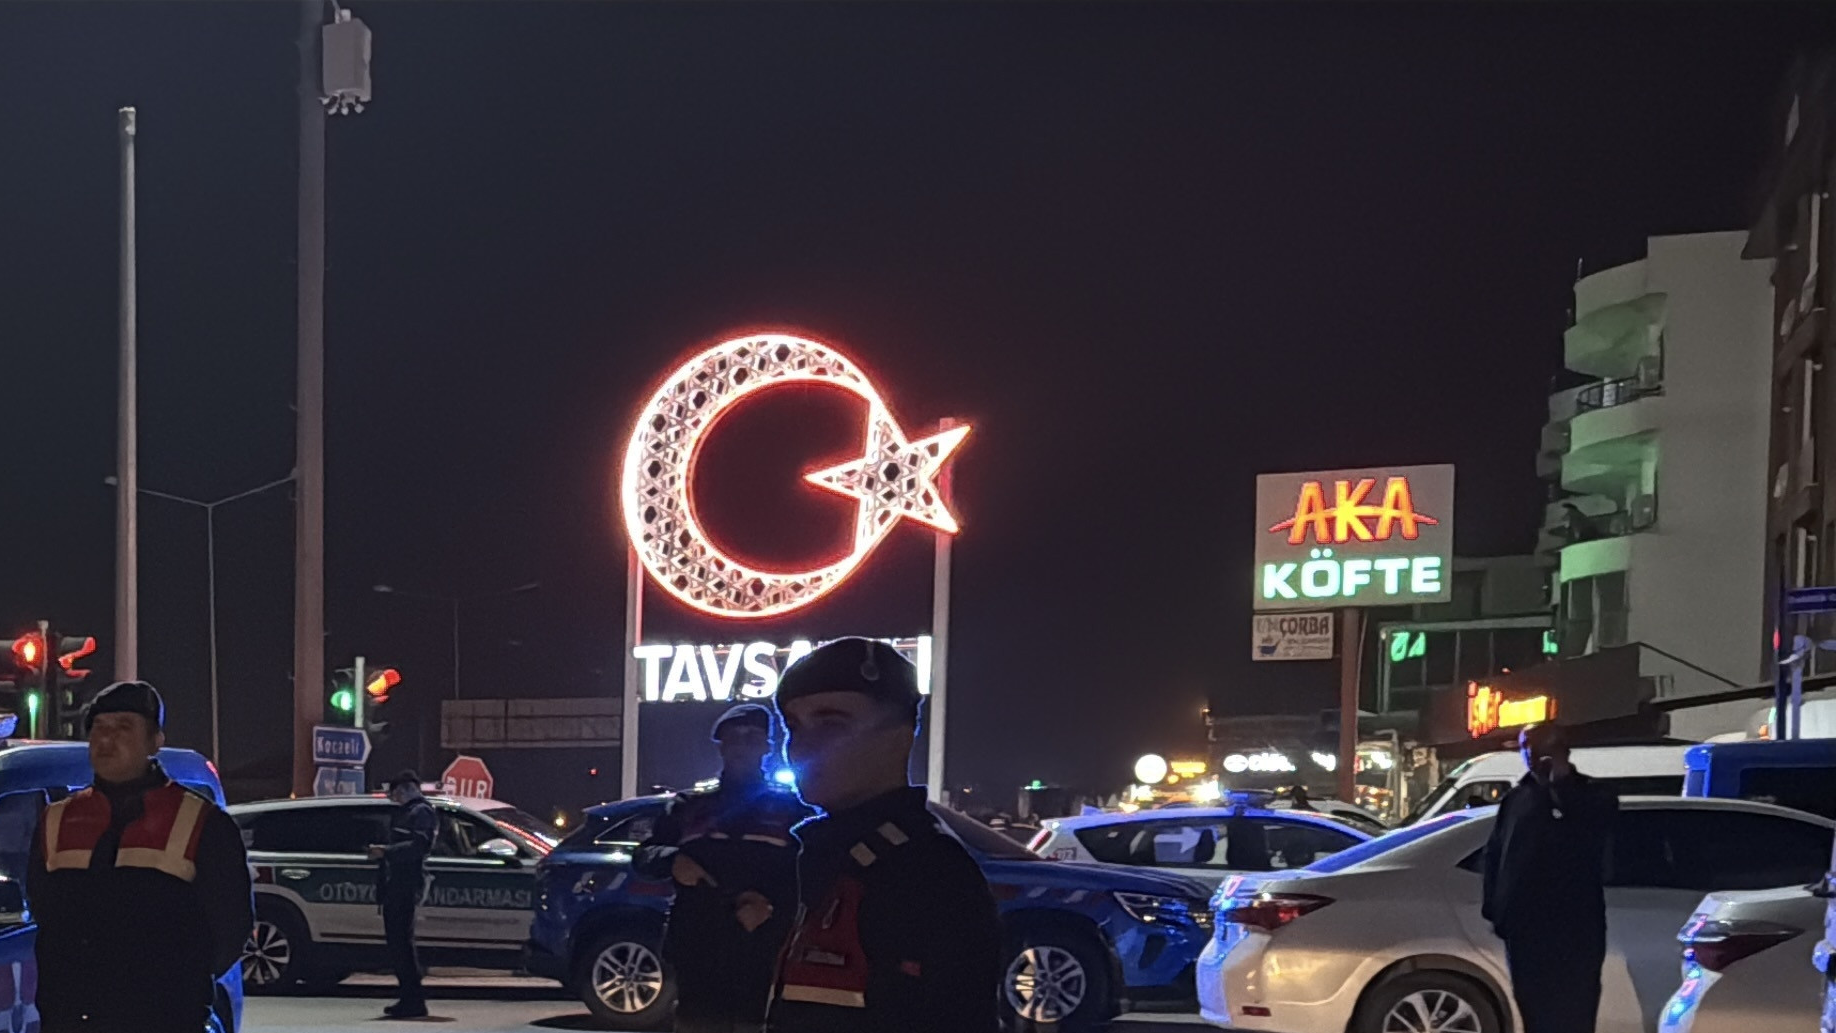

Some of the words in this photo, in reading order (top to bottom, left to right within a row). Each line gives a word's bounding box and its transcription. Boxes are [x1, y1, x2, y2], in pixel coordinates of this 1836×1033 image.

[1285, 476, 1420, 545] AKA
[1263, 548, 1442, 599] KÖFTE
[1279, 616, 1330, 637] ÇORBA
[316, 736, 361, 756] Kocaeli
